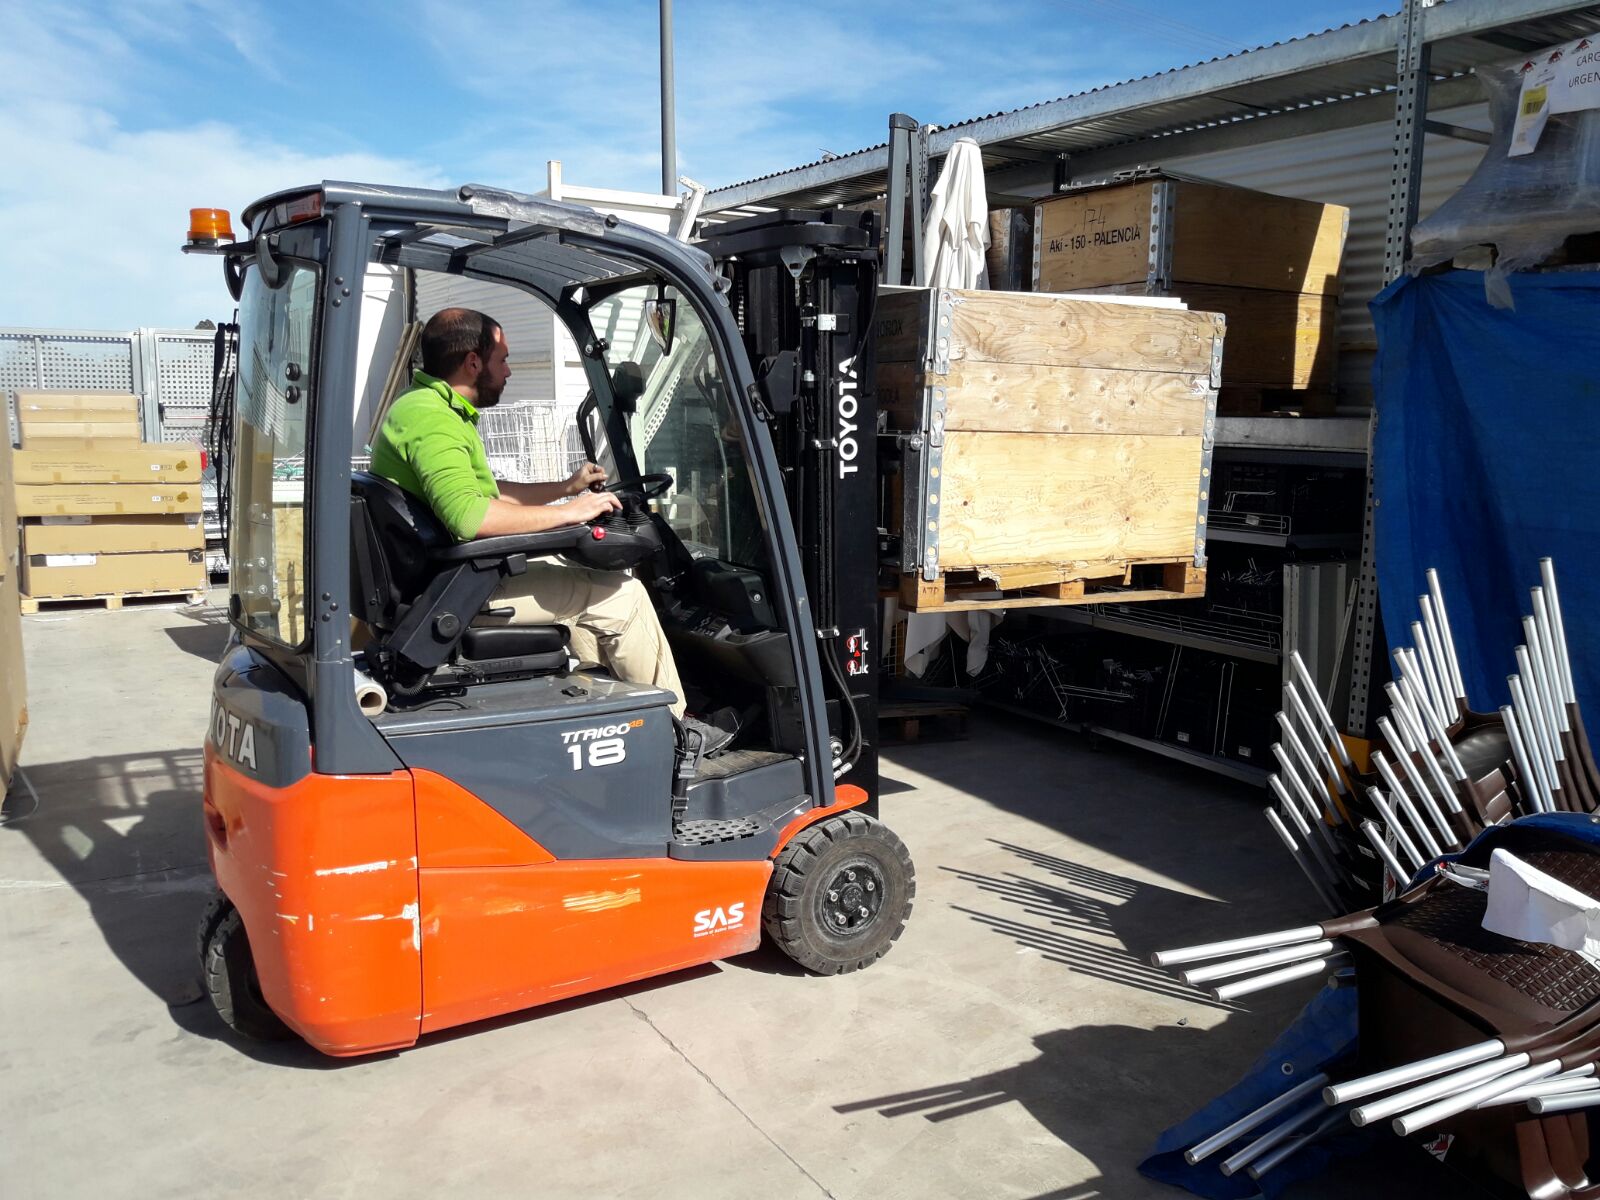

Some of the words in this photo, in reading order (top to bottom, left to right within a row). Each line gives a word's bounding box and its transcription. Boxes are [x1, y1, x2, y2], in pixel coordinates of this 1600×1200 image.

[1071, 235, 1086, 250] 150
[1094, 228, 1140, 247] PALENCIA
[838, 355, 859, 480] TOYOTA
[567, 738, 626, 771] 18
[693, 902, 745, 933] SAS
